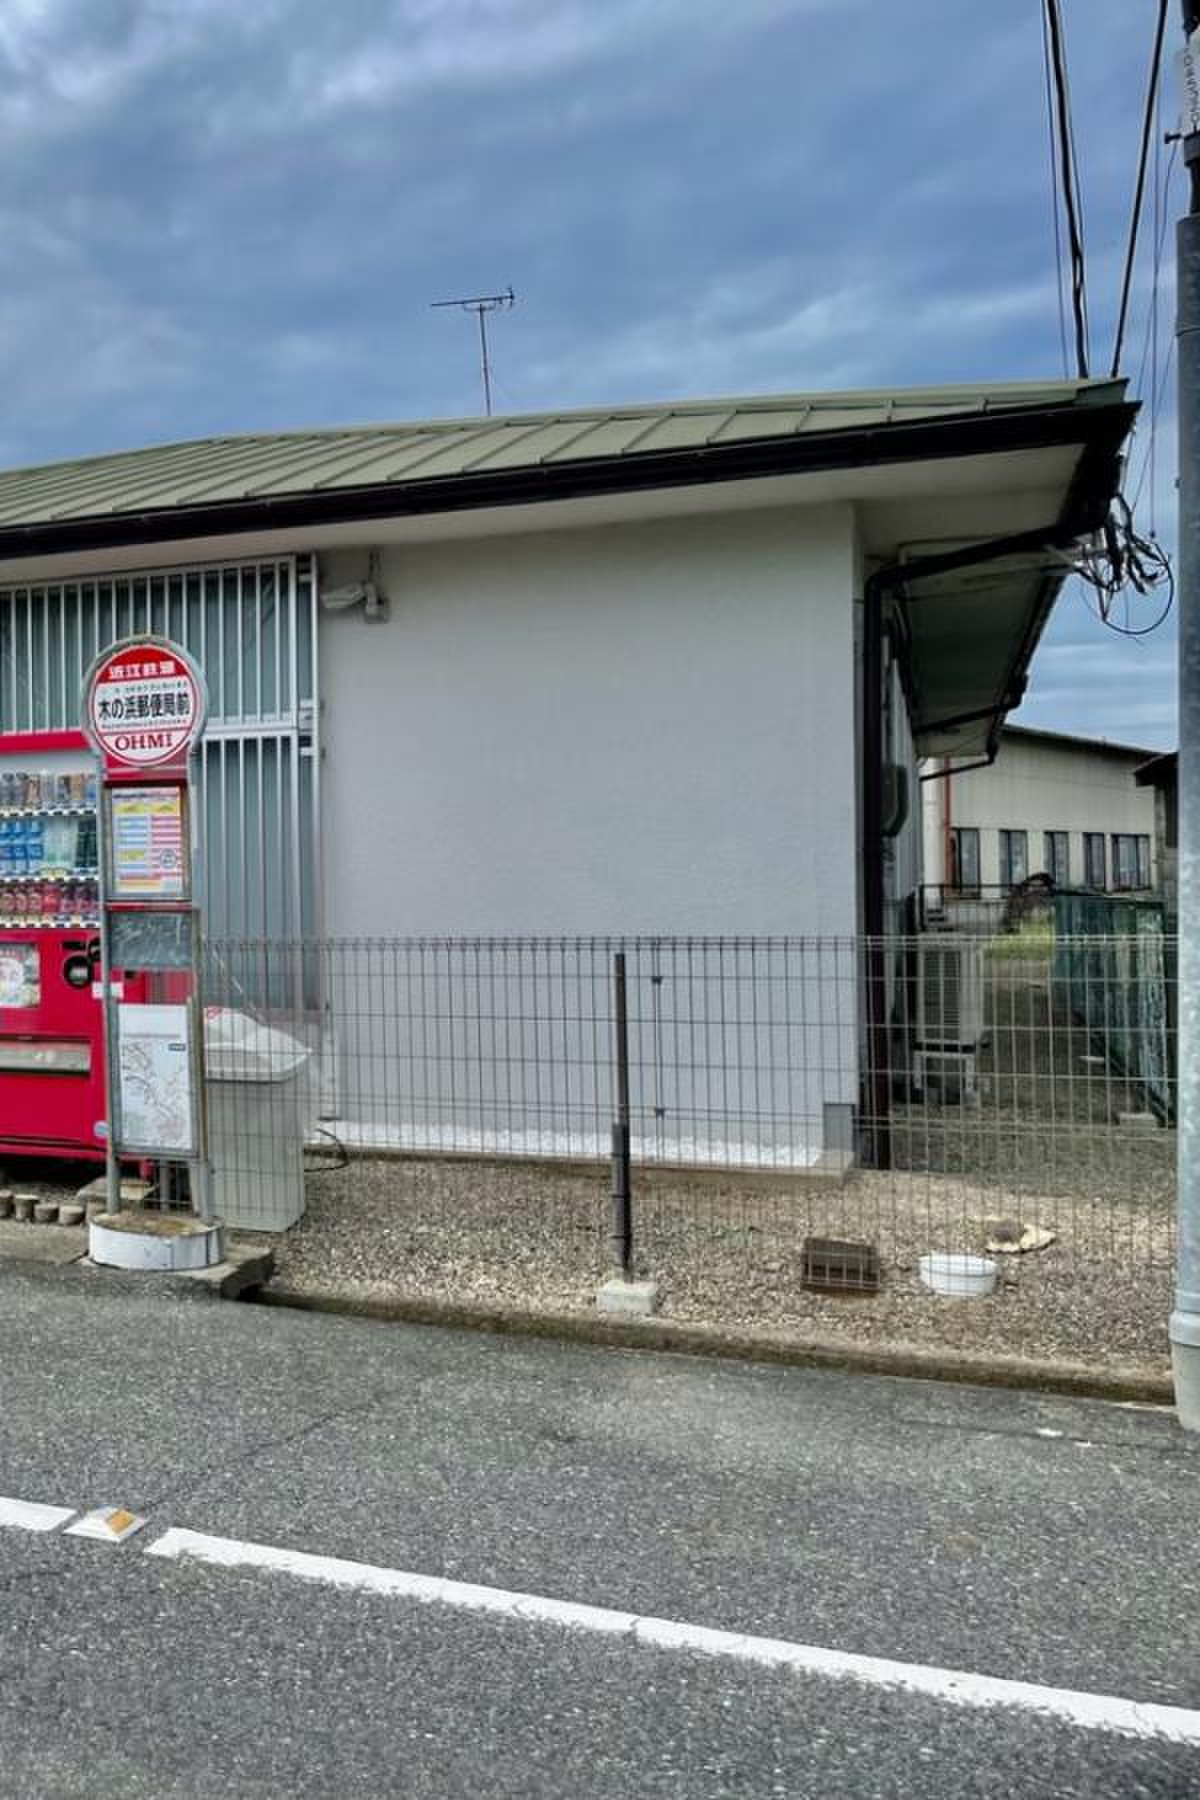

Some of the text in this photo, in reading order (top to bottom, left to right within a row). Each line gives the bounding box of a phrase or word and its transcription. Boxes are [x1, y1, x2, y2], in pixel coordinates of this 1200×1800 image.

[98, 692, 189, 720] 木の浜郵便局前
[115, 734, 173, 750] OHMI
